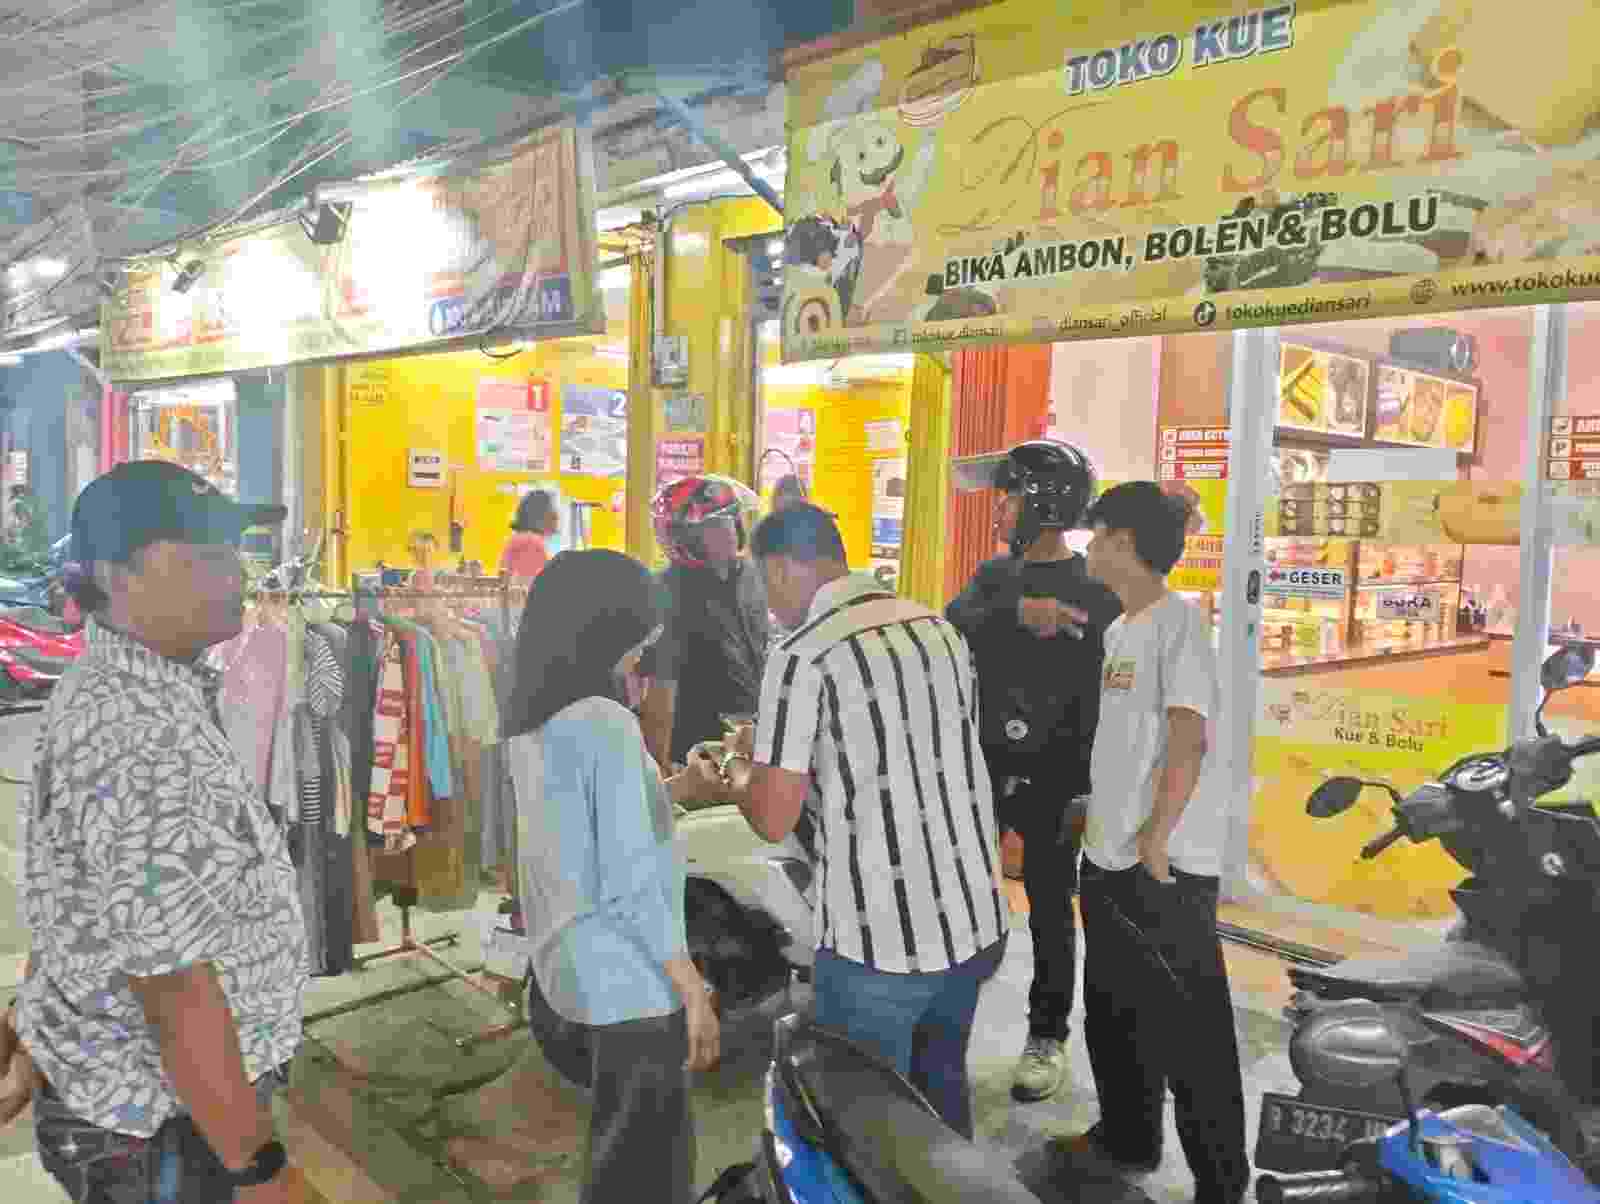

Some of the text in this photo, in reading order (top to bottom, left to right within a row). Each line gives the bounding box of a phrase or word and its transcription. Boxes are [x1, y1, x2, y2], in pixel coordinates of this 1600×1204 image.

[1065, 4, 1294, 94] TOKO KUE
[1216, 48, 1463, 194] Sari
[944, 194, 1438, 287] BIKA AMBON, BOLEN & BOLU
[532, 384, 544, 409] 1
[612, 391, 626, 416] 2
[1289, 572, 1342, 586] GESER
[1368, 730, 1380, 745] &
[1386, 734, 1424, 753] Bolu
